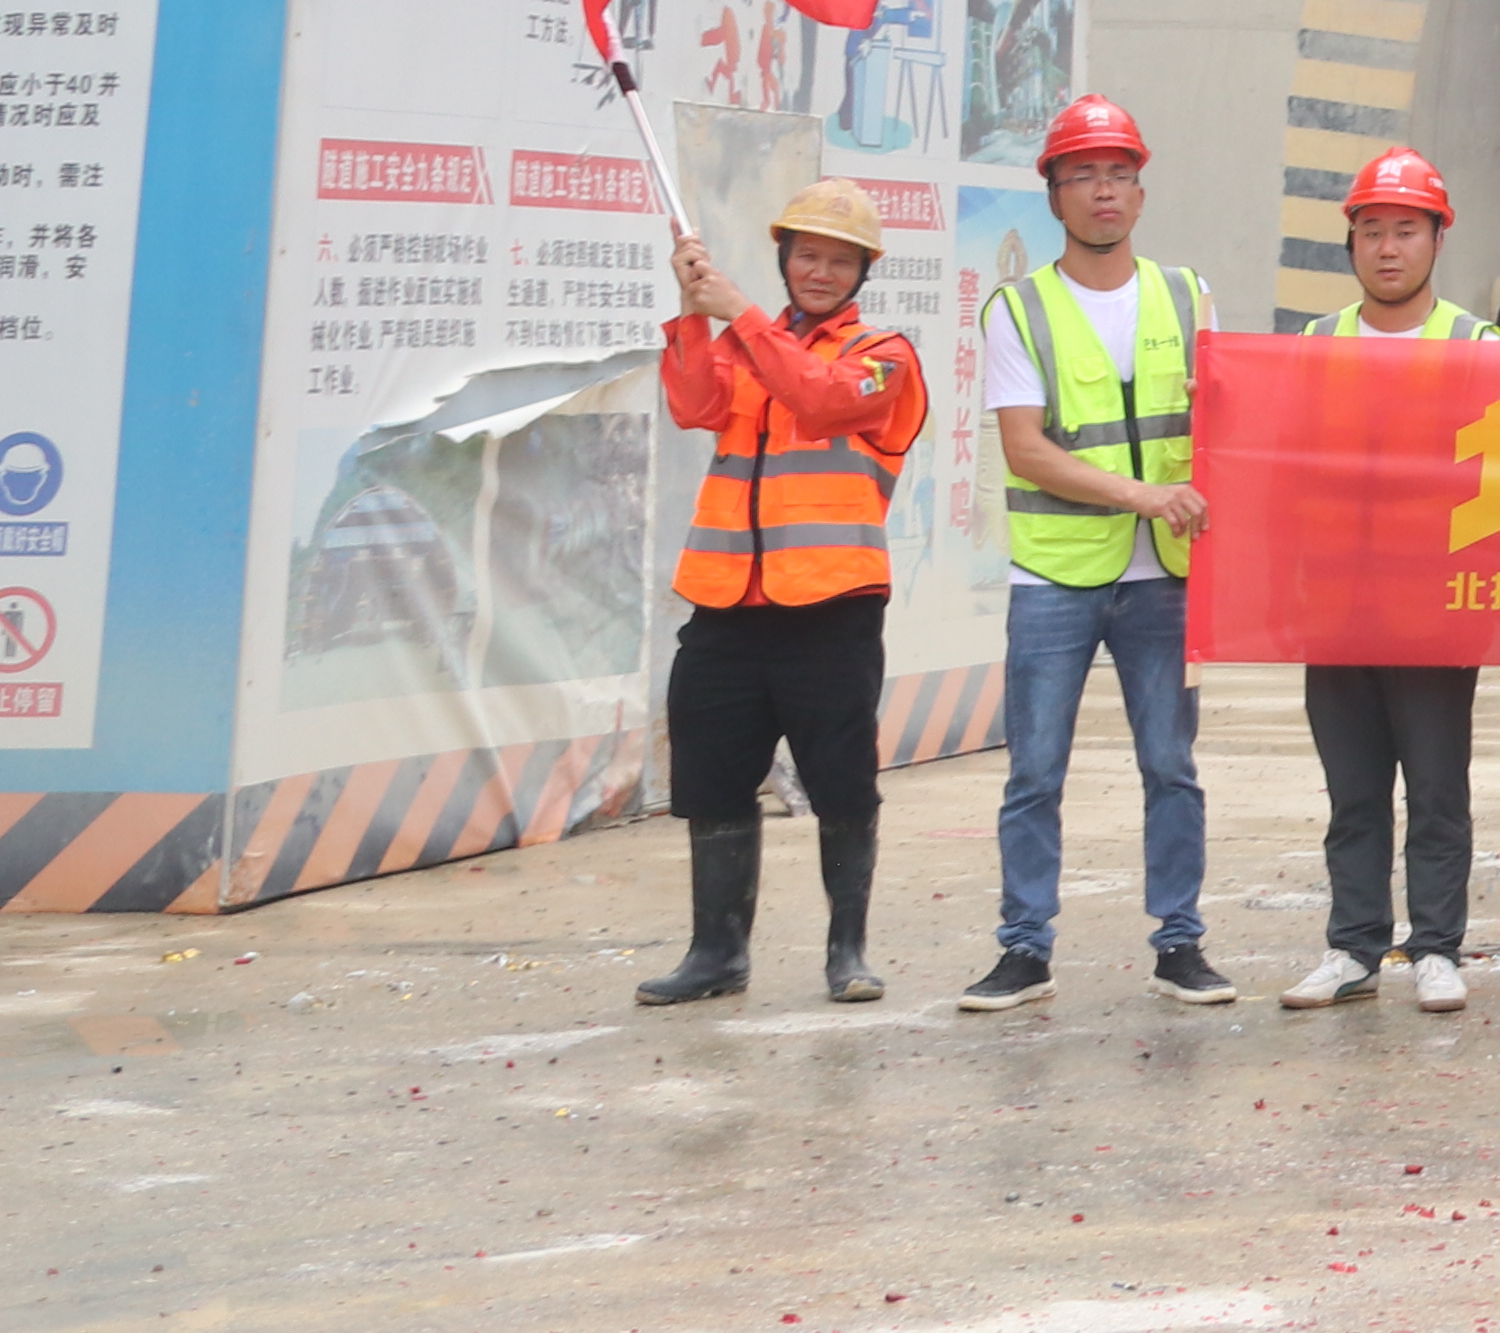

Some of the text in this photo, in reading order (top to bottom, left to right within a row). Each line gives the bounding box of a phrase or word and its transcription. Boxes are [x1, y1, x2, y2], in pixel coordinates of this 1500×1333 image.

[0, 13, 119, 37] 现异常及时
[0, 103, 100, 127] 况时应及
[322, 148, 475, 194] 隧道施工安全九条规定
